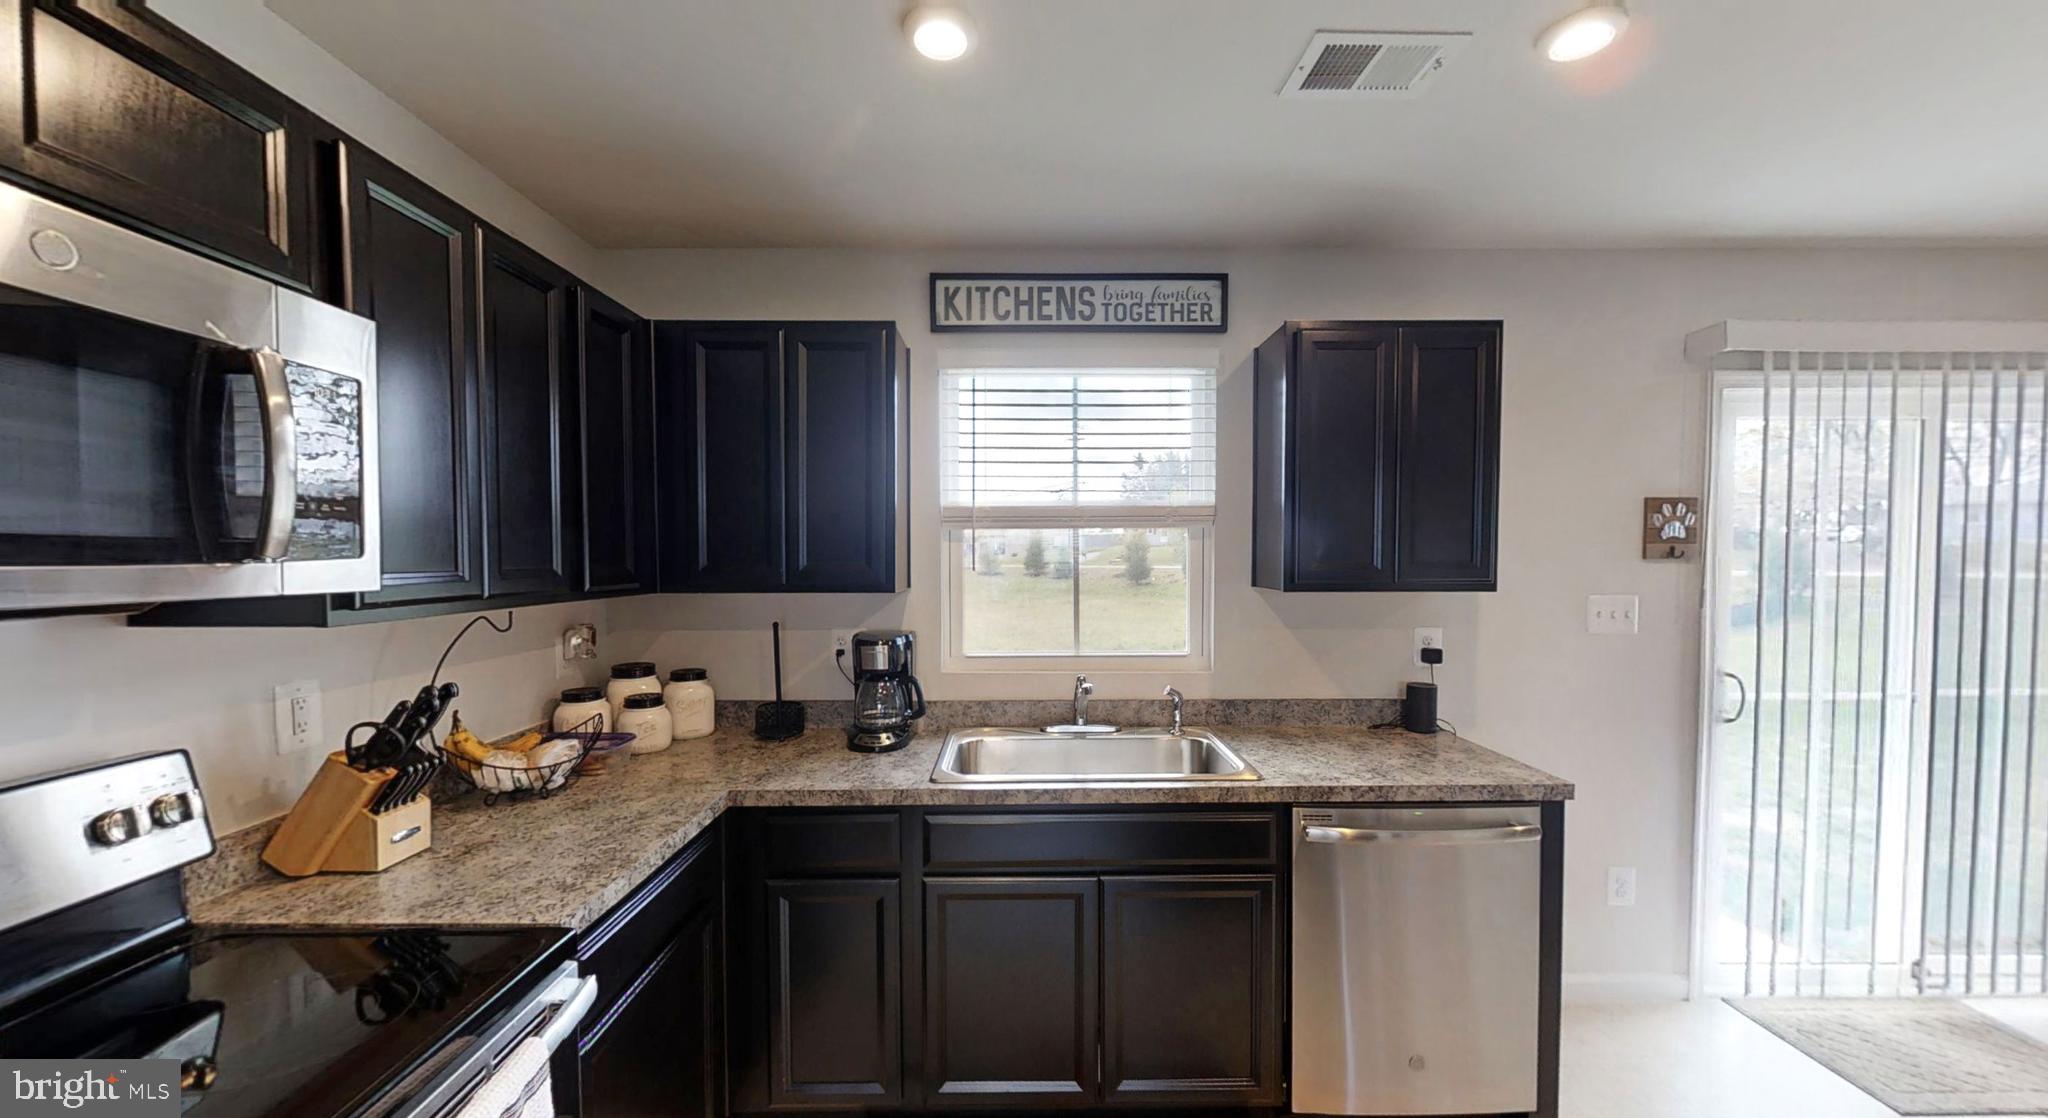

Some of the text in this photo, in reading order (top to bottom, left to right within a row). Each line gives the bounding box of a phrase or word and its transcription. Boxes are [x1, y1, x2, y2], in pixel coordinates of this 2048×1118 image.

[943, 285, 1096, 322] KITCHENS
[1102, 284, 1211, 303] bring families
[1101, 302, 1214, 323] TOGETHER
